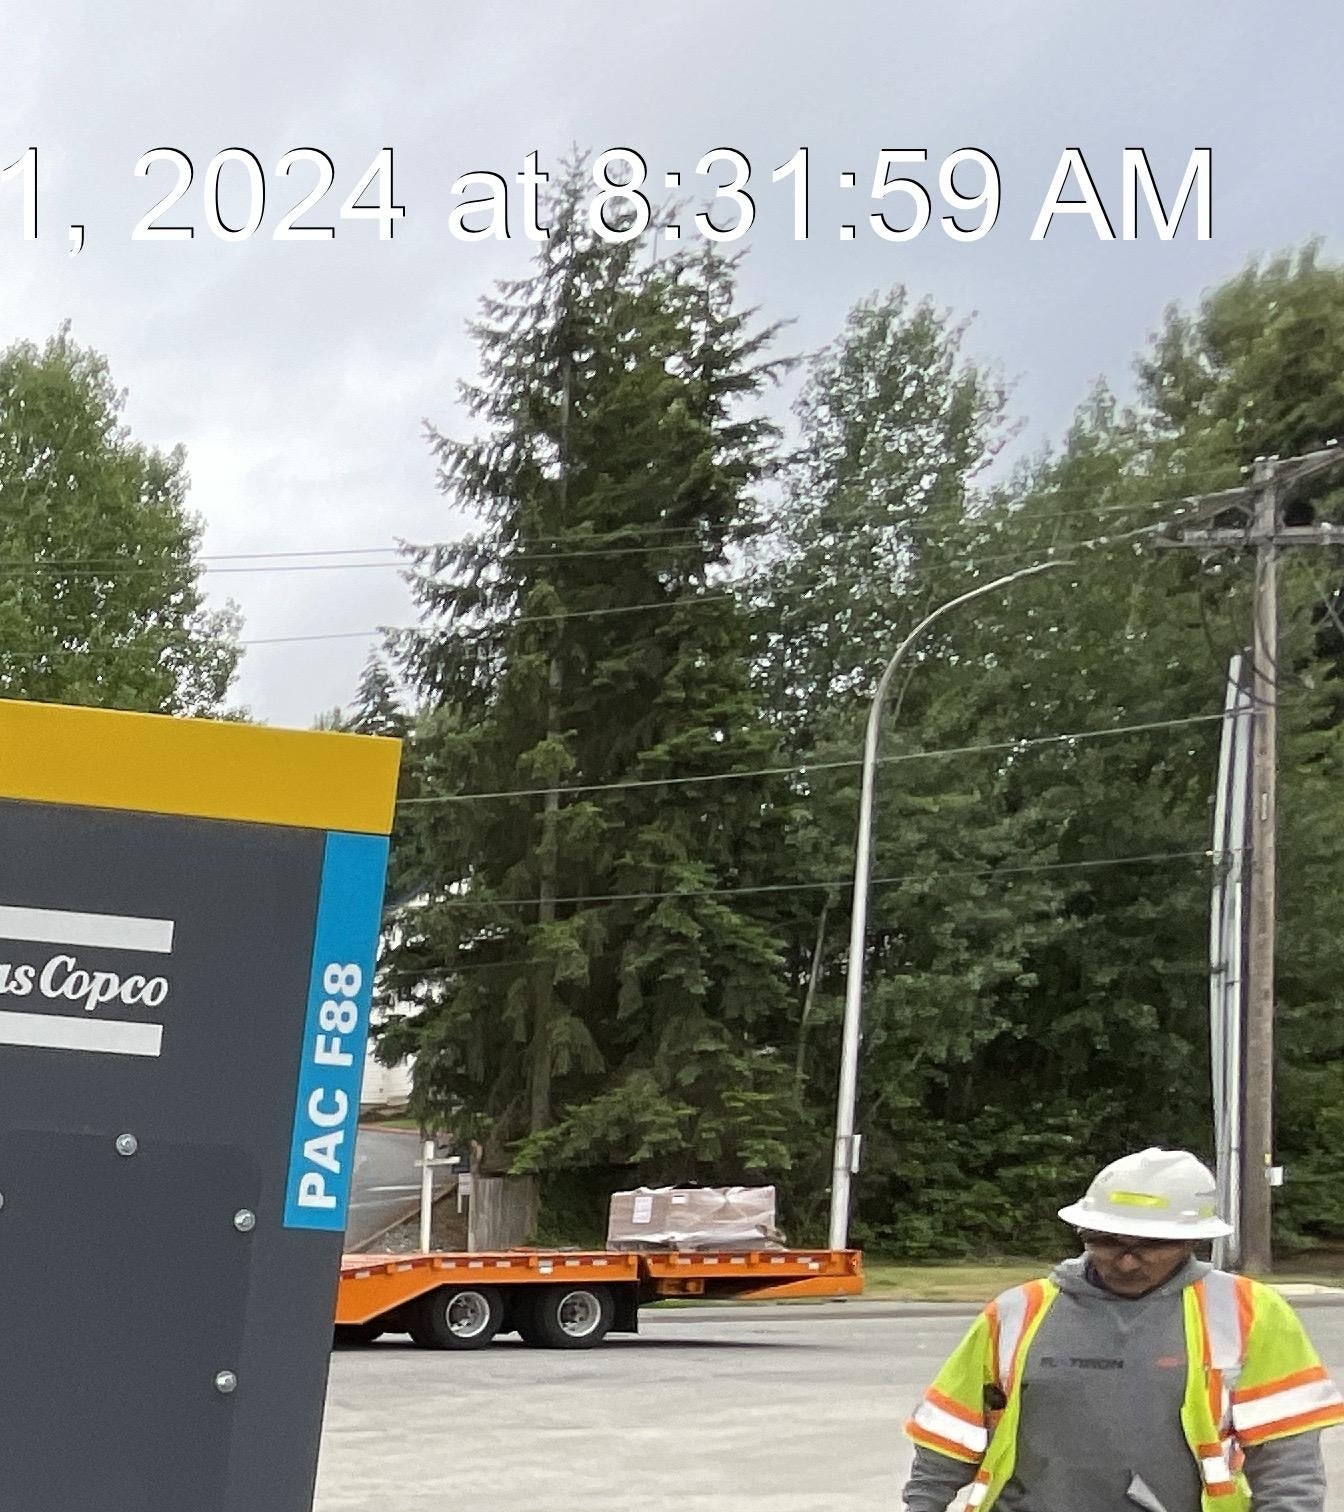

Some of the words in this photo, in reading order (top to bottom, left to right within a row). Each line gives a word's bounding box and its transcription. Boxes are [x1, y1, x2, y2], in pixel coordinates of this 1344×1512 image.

[39, 953, 170, 1011] Copco
[313, 961, 363, 1067] F88
[297, 1086, 349, 1210] PAC
